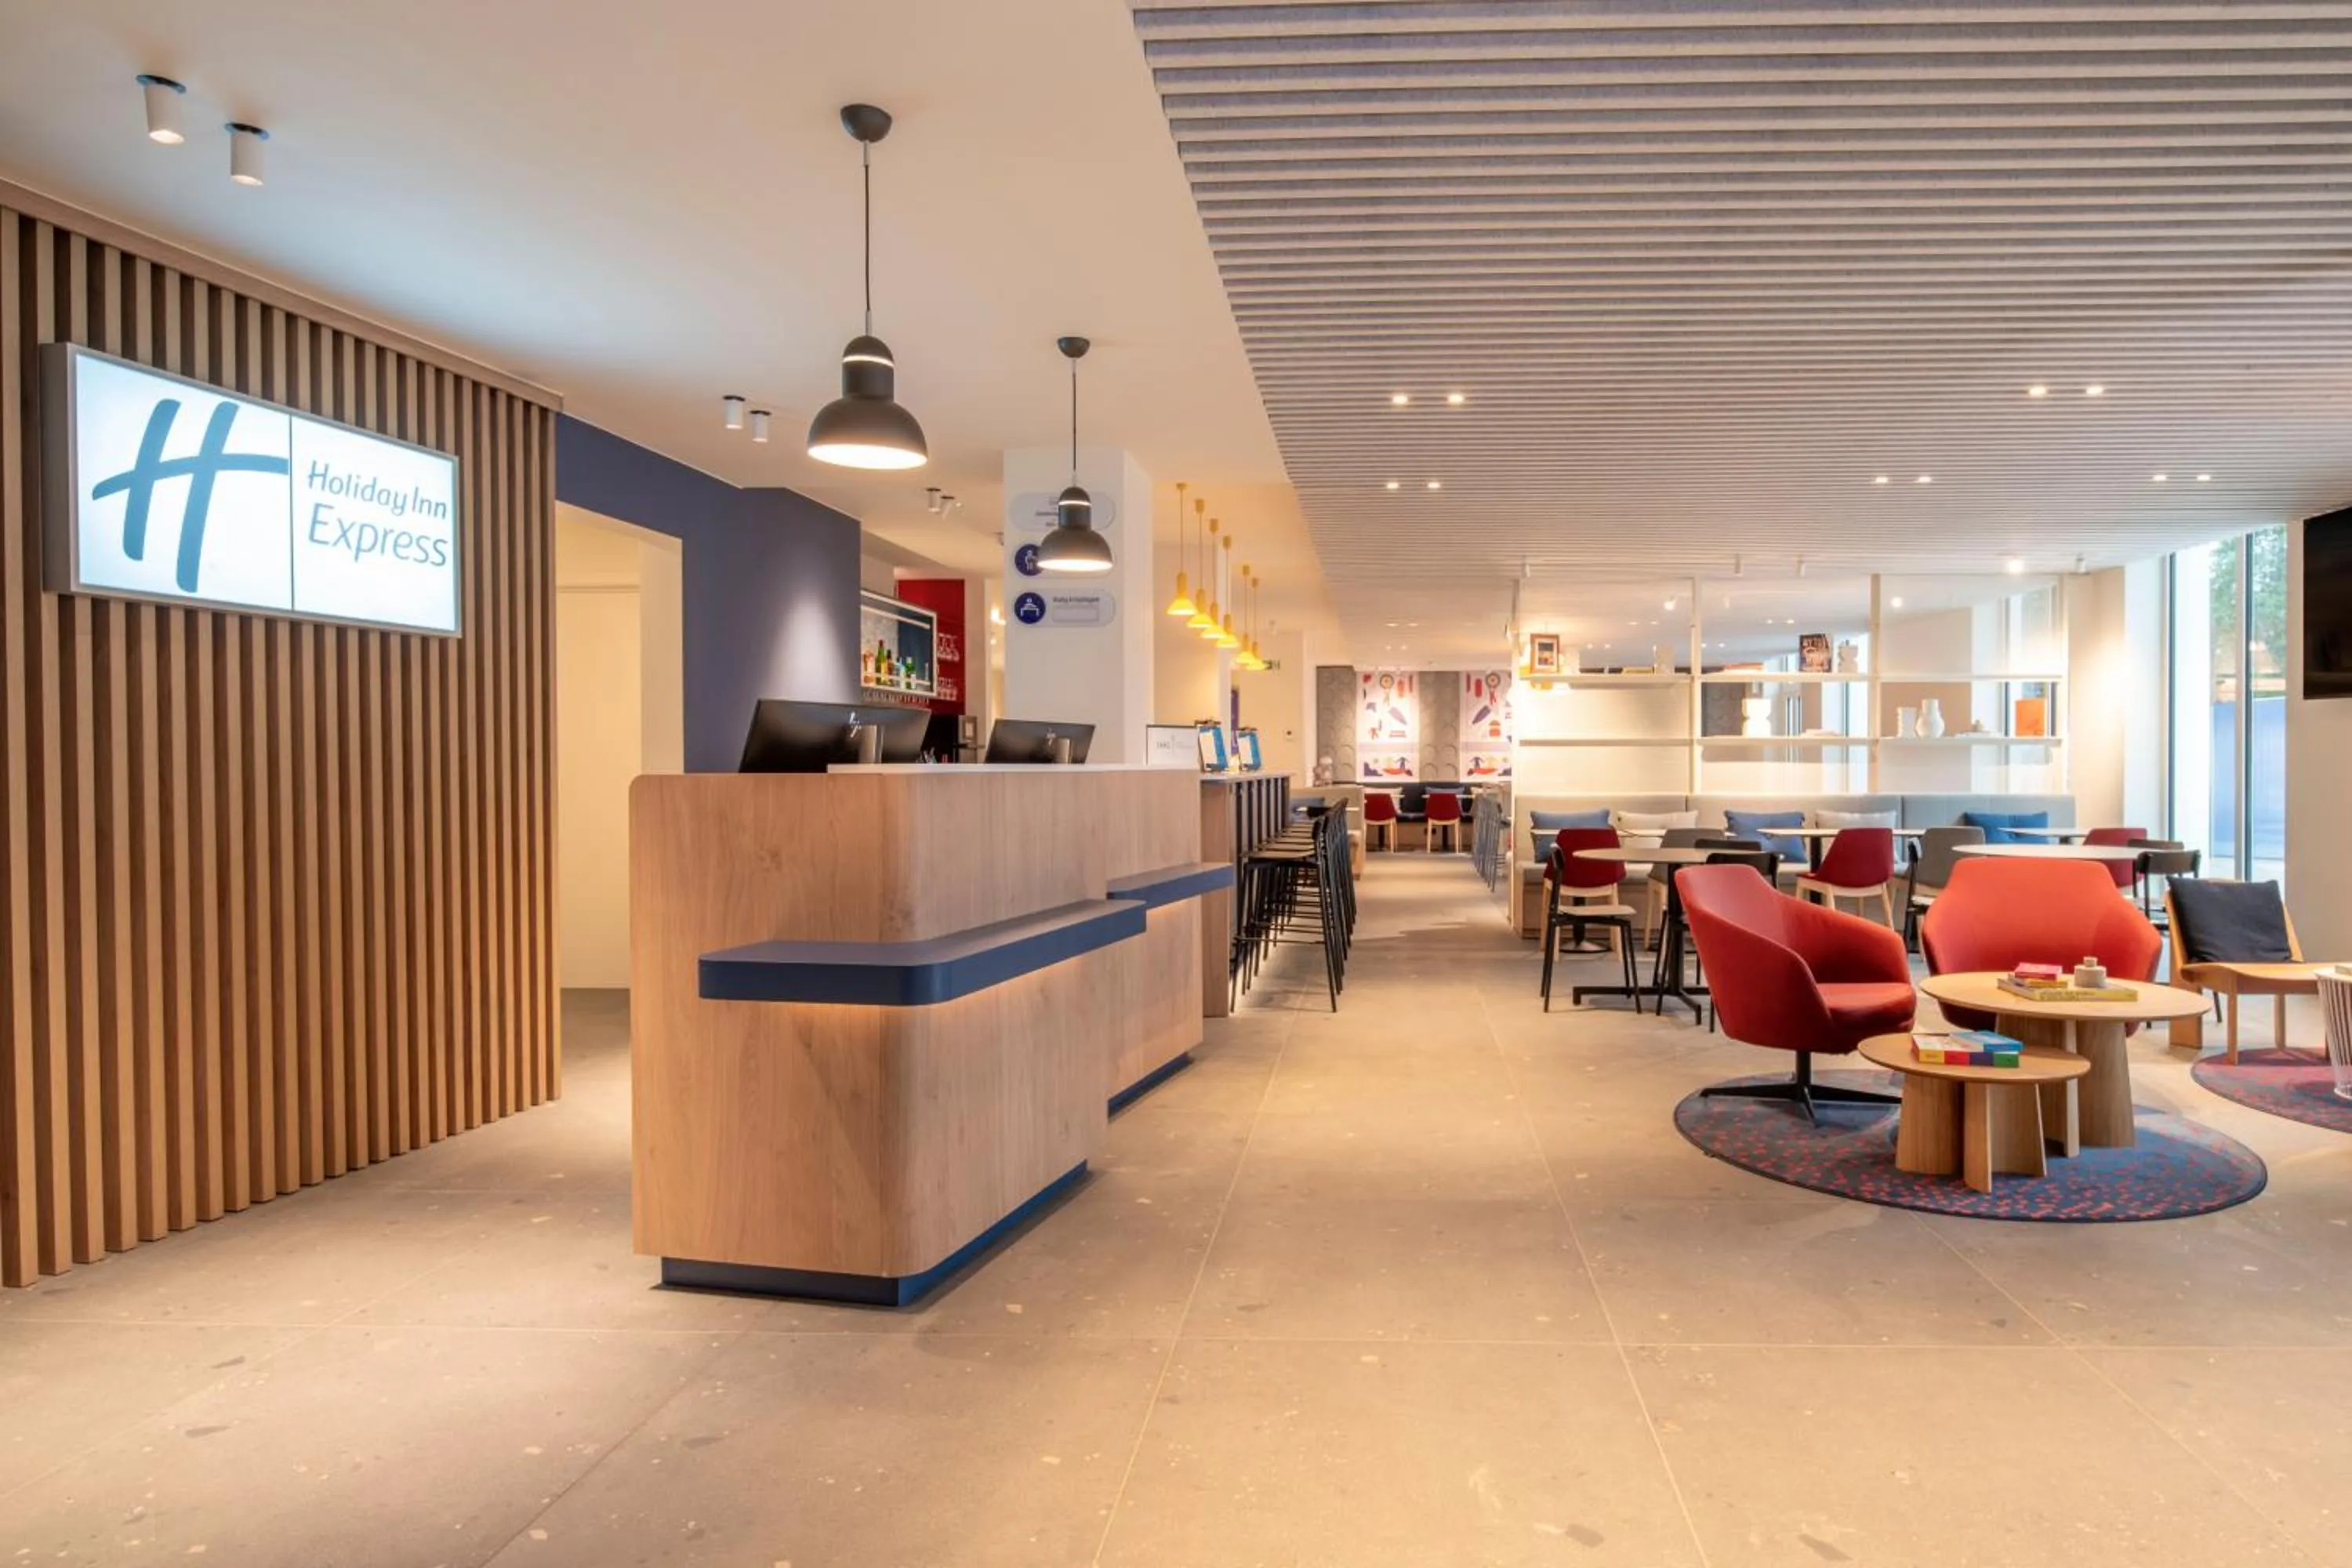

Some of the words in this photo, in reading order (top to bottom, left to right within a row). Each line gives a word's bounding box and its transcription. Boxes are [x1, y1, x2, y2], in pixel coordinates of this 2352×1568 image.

[307, 459, 408, 517] Holiday
[412, 486, 448, 520] Inn
[308, 502, 448, 567] Express
